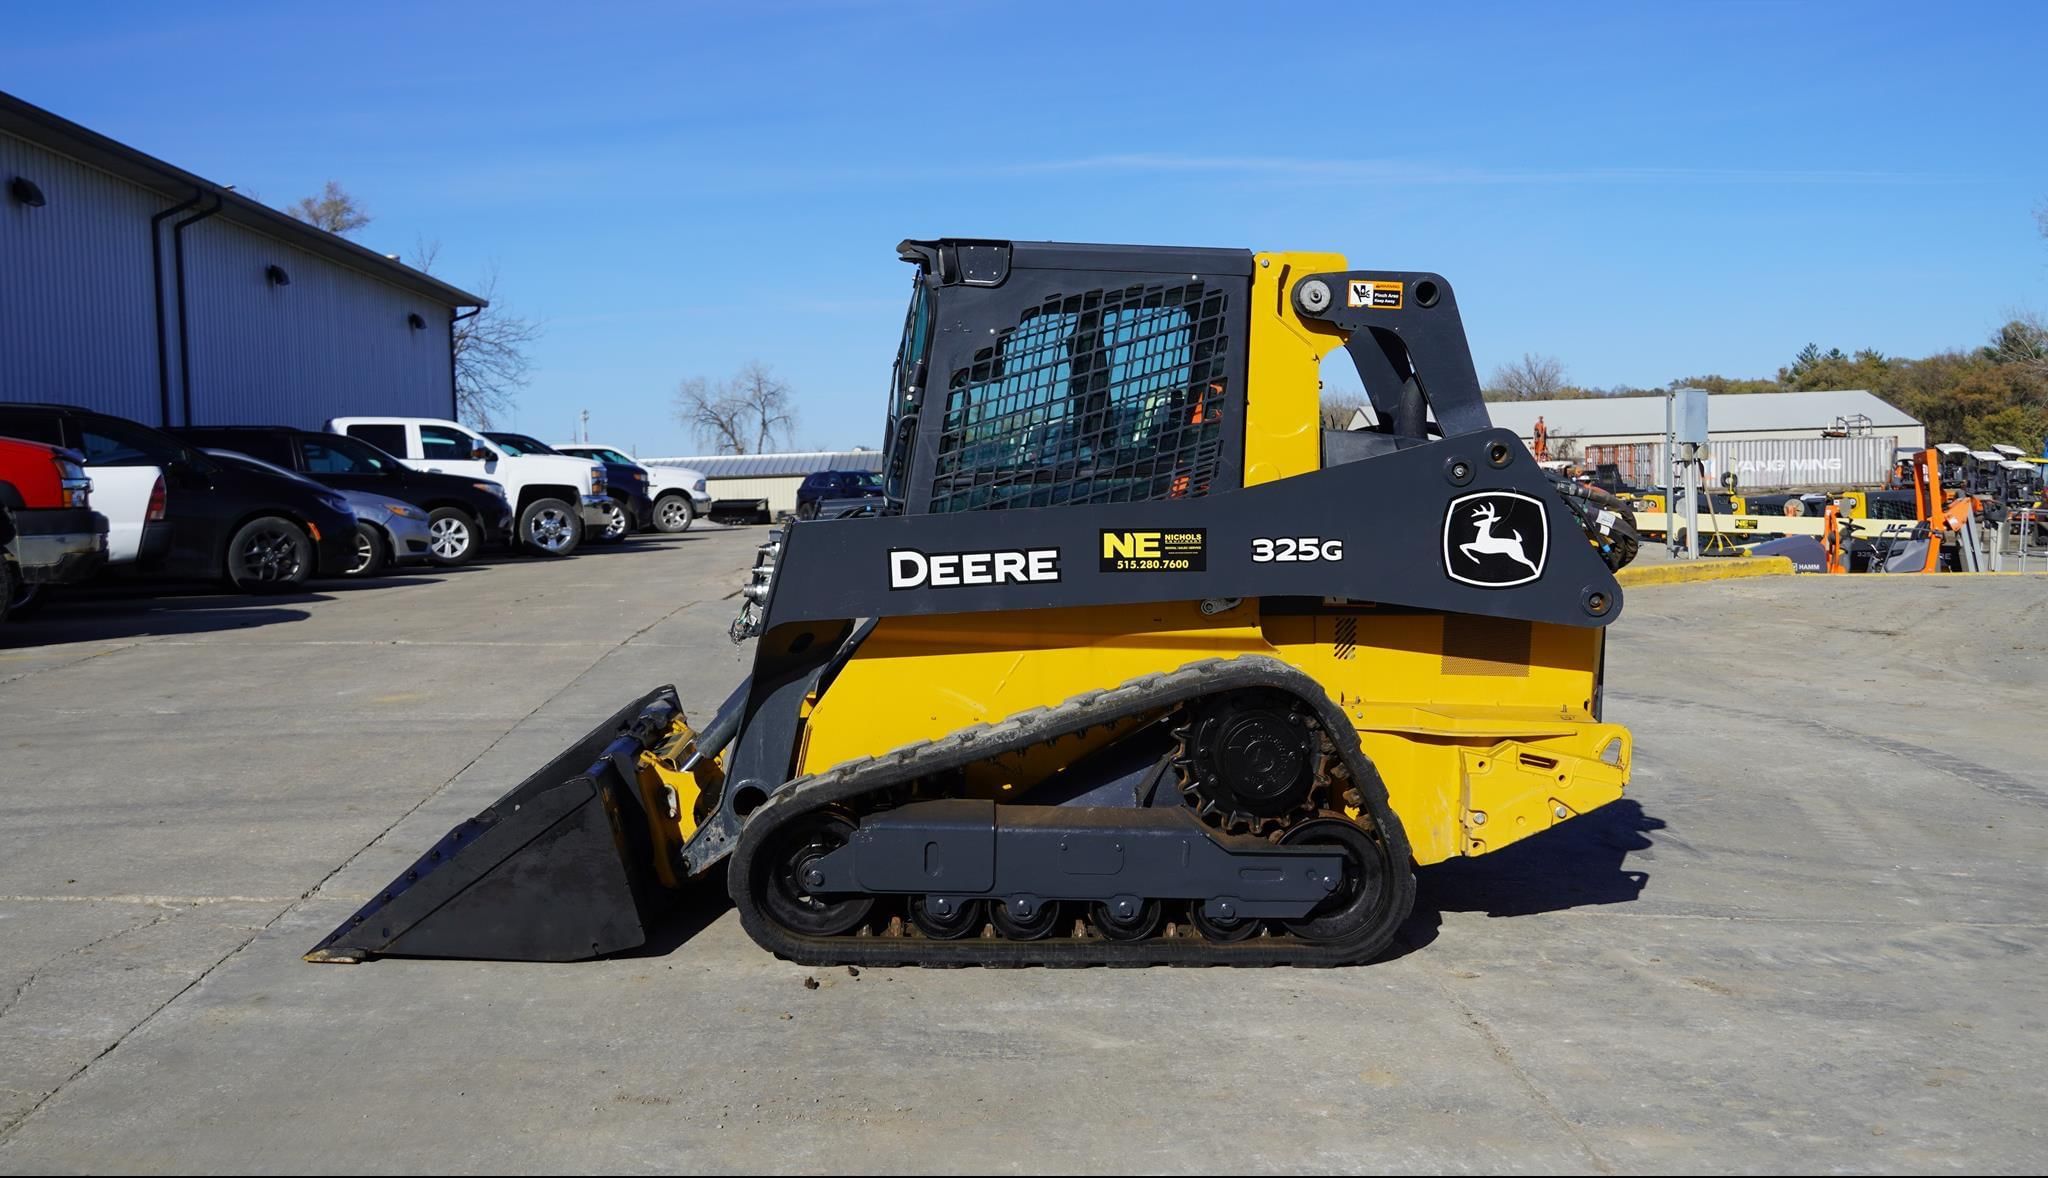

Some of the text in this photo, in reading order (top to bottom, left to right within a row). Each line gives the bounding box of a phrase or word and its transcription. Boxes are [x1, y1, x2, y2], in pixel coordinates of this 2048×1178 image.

[1790, 458, 1841, 470] MING
[1103, 532, 1161, 558] NE
[1164, 533, 1202, 541] NICHOLS
[1252, 538, 1342, 561] 325G
[890, 550, 1058, 588] DEERE
[1117, 559, 1189, 569] 515.280.7600
